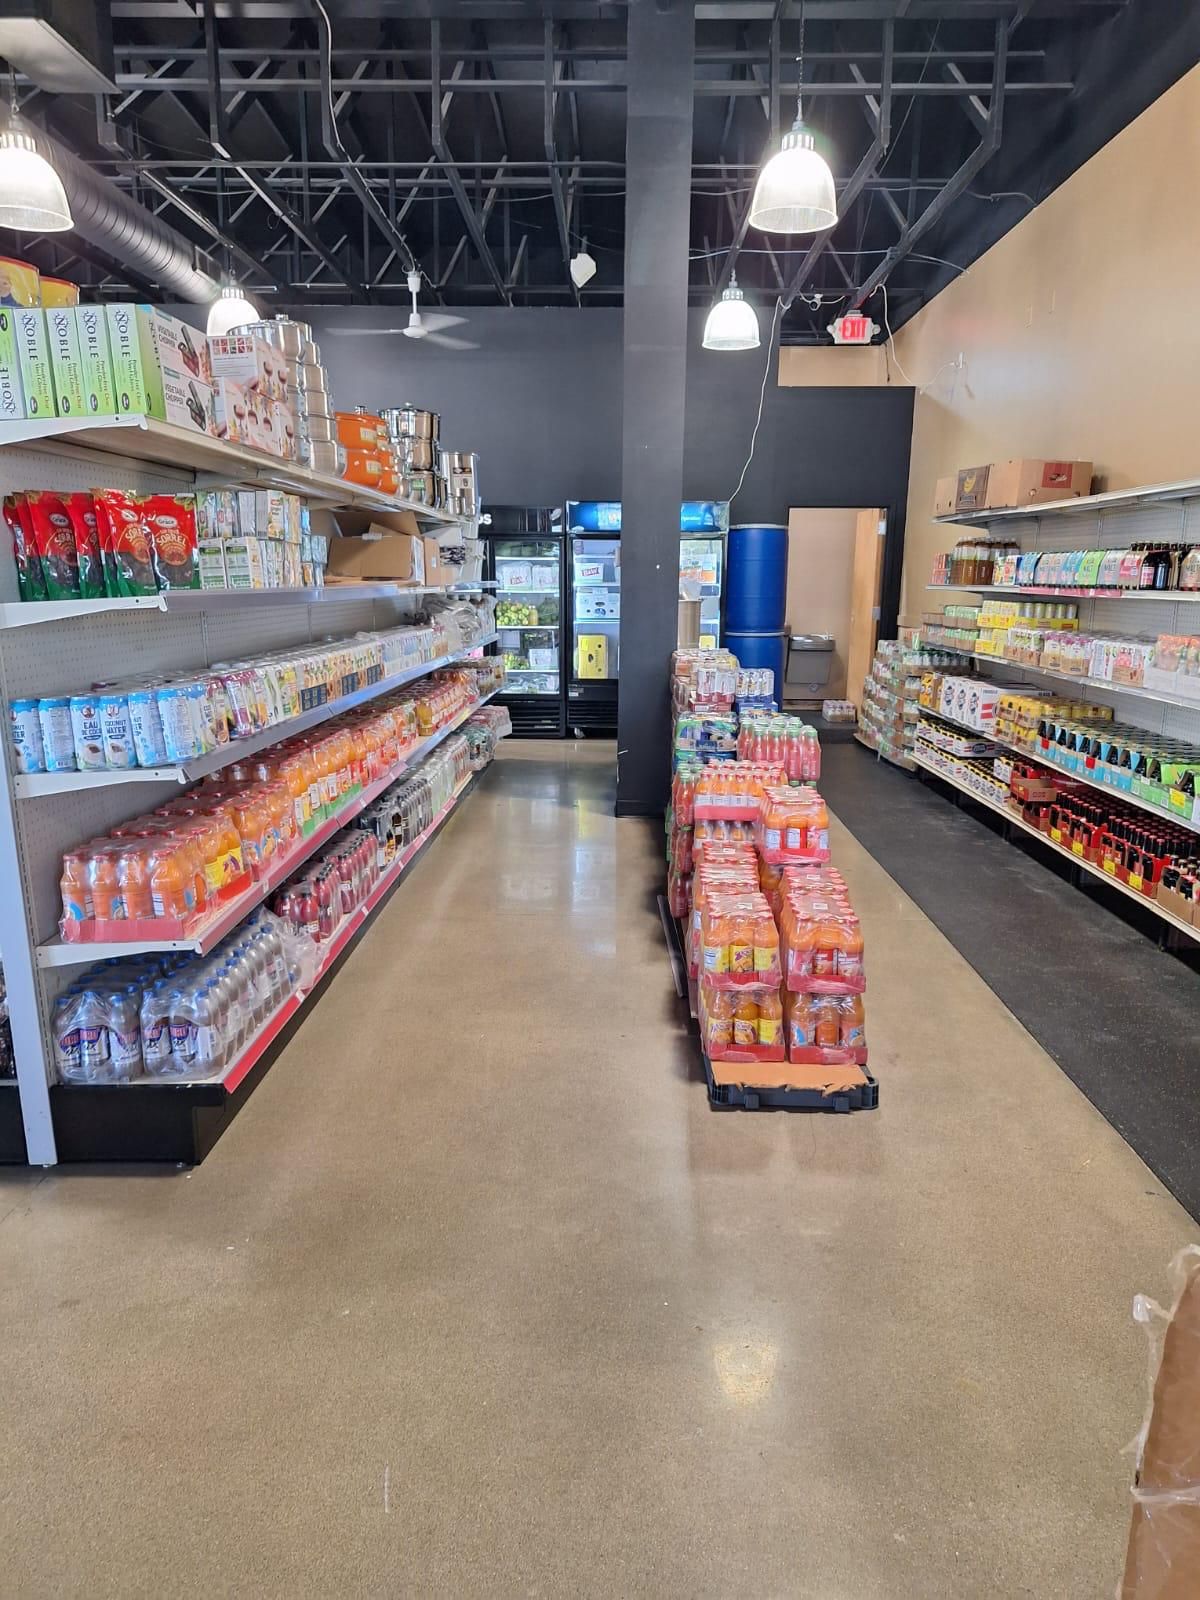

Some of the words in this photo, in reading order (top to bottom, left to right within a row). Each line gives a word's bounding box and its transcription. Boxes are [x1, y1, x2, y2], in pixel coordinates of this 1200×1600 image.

[24, 312, 38, 360] NOBLE
[56, 312, 70, 360] NOBLE
[85, 310, 99, 358] NOBLE
[116, 309, 131, 357] NOBLE
[842, 318, 868, 339] EXIT
[156, 533, 186, 546] SORREL
[83, 720, 99, 729] EAU
[104, 719, 126, 732] COCONUT
[106, 726, 127, 734] WATER
